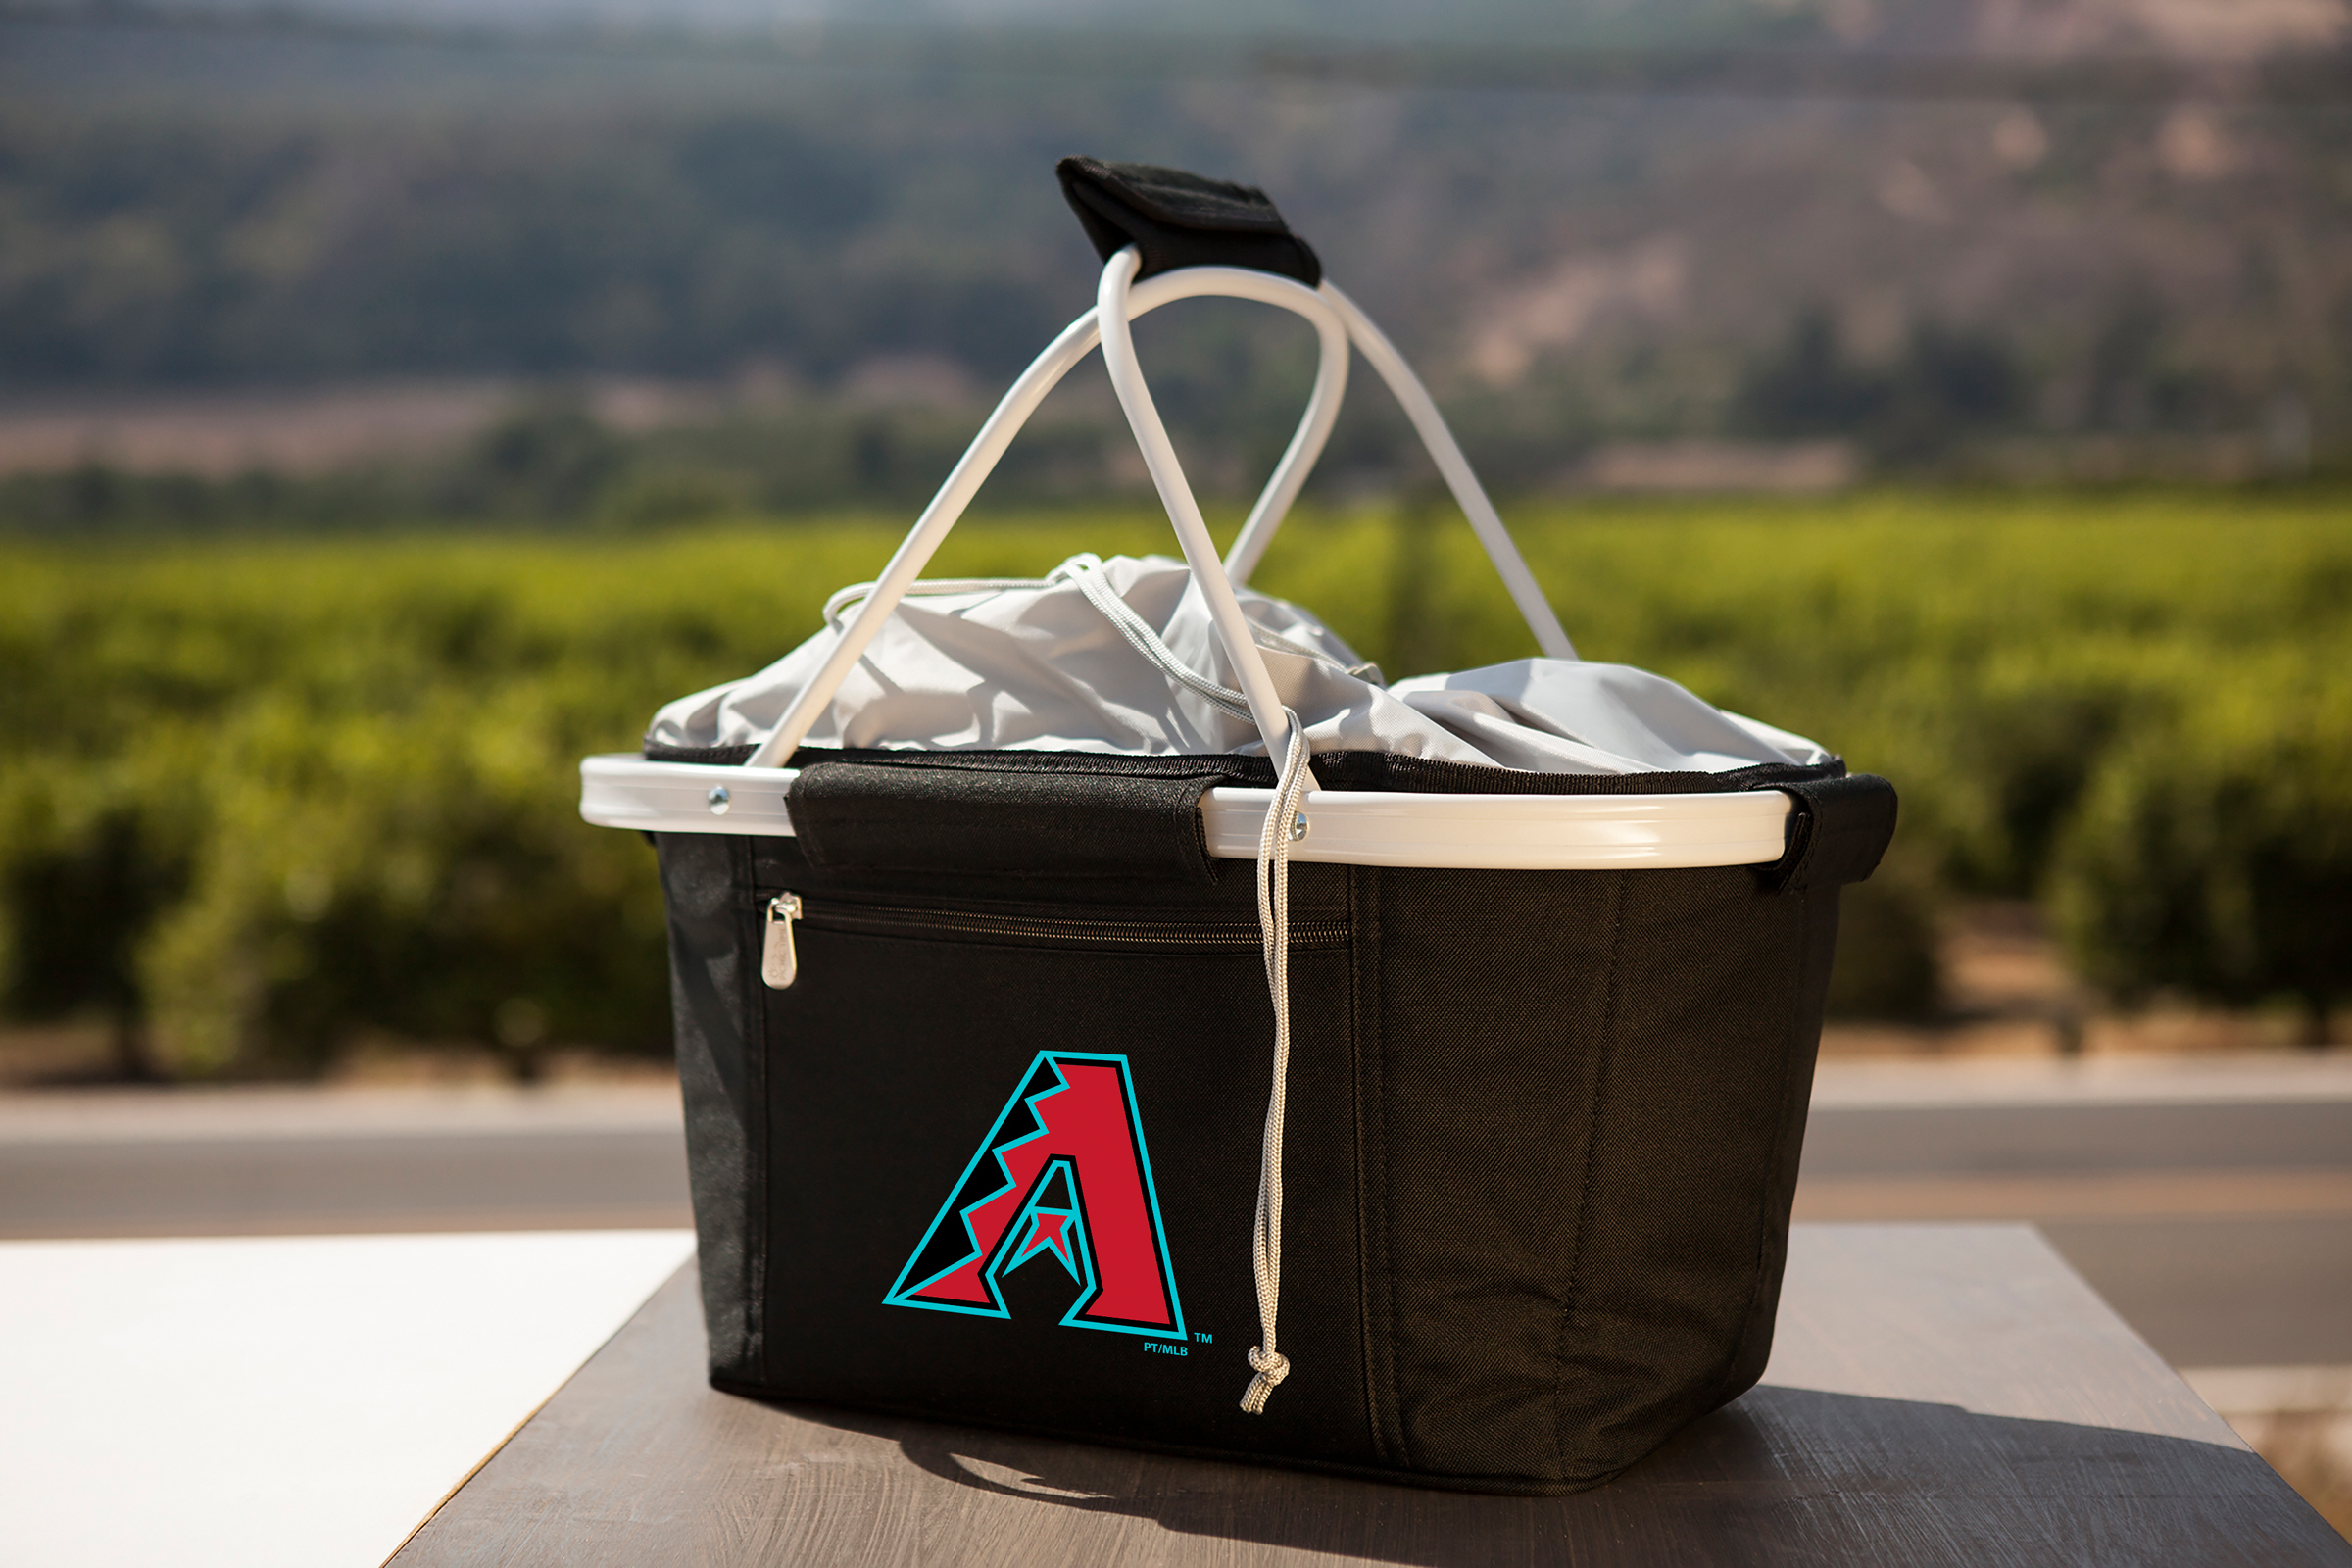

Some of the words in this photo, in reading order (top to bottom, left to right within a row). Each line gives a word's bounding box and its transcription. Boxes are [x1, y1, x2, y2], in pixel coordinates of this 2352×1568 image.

[881, 1049, 1188, 1341] A
[1194, 1332, 1212, 1344] TM
[1144, 1342, 1188, 1356] PT/MLB
